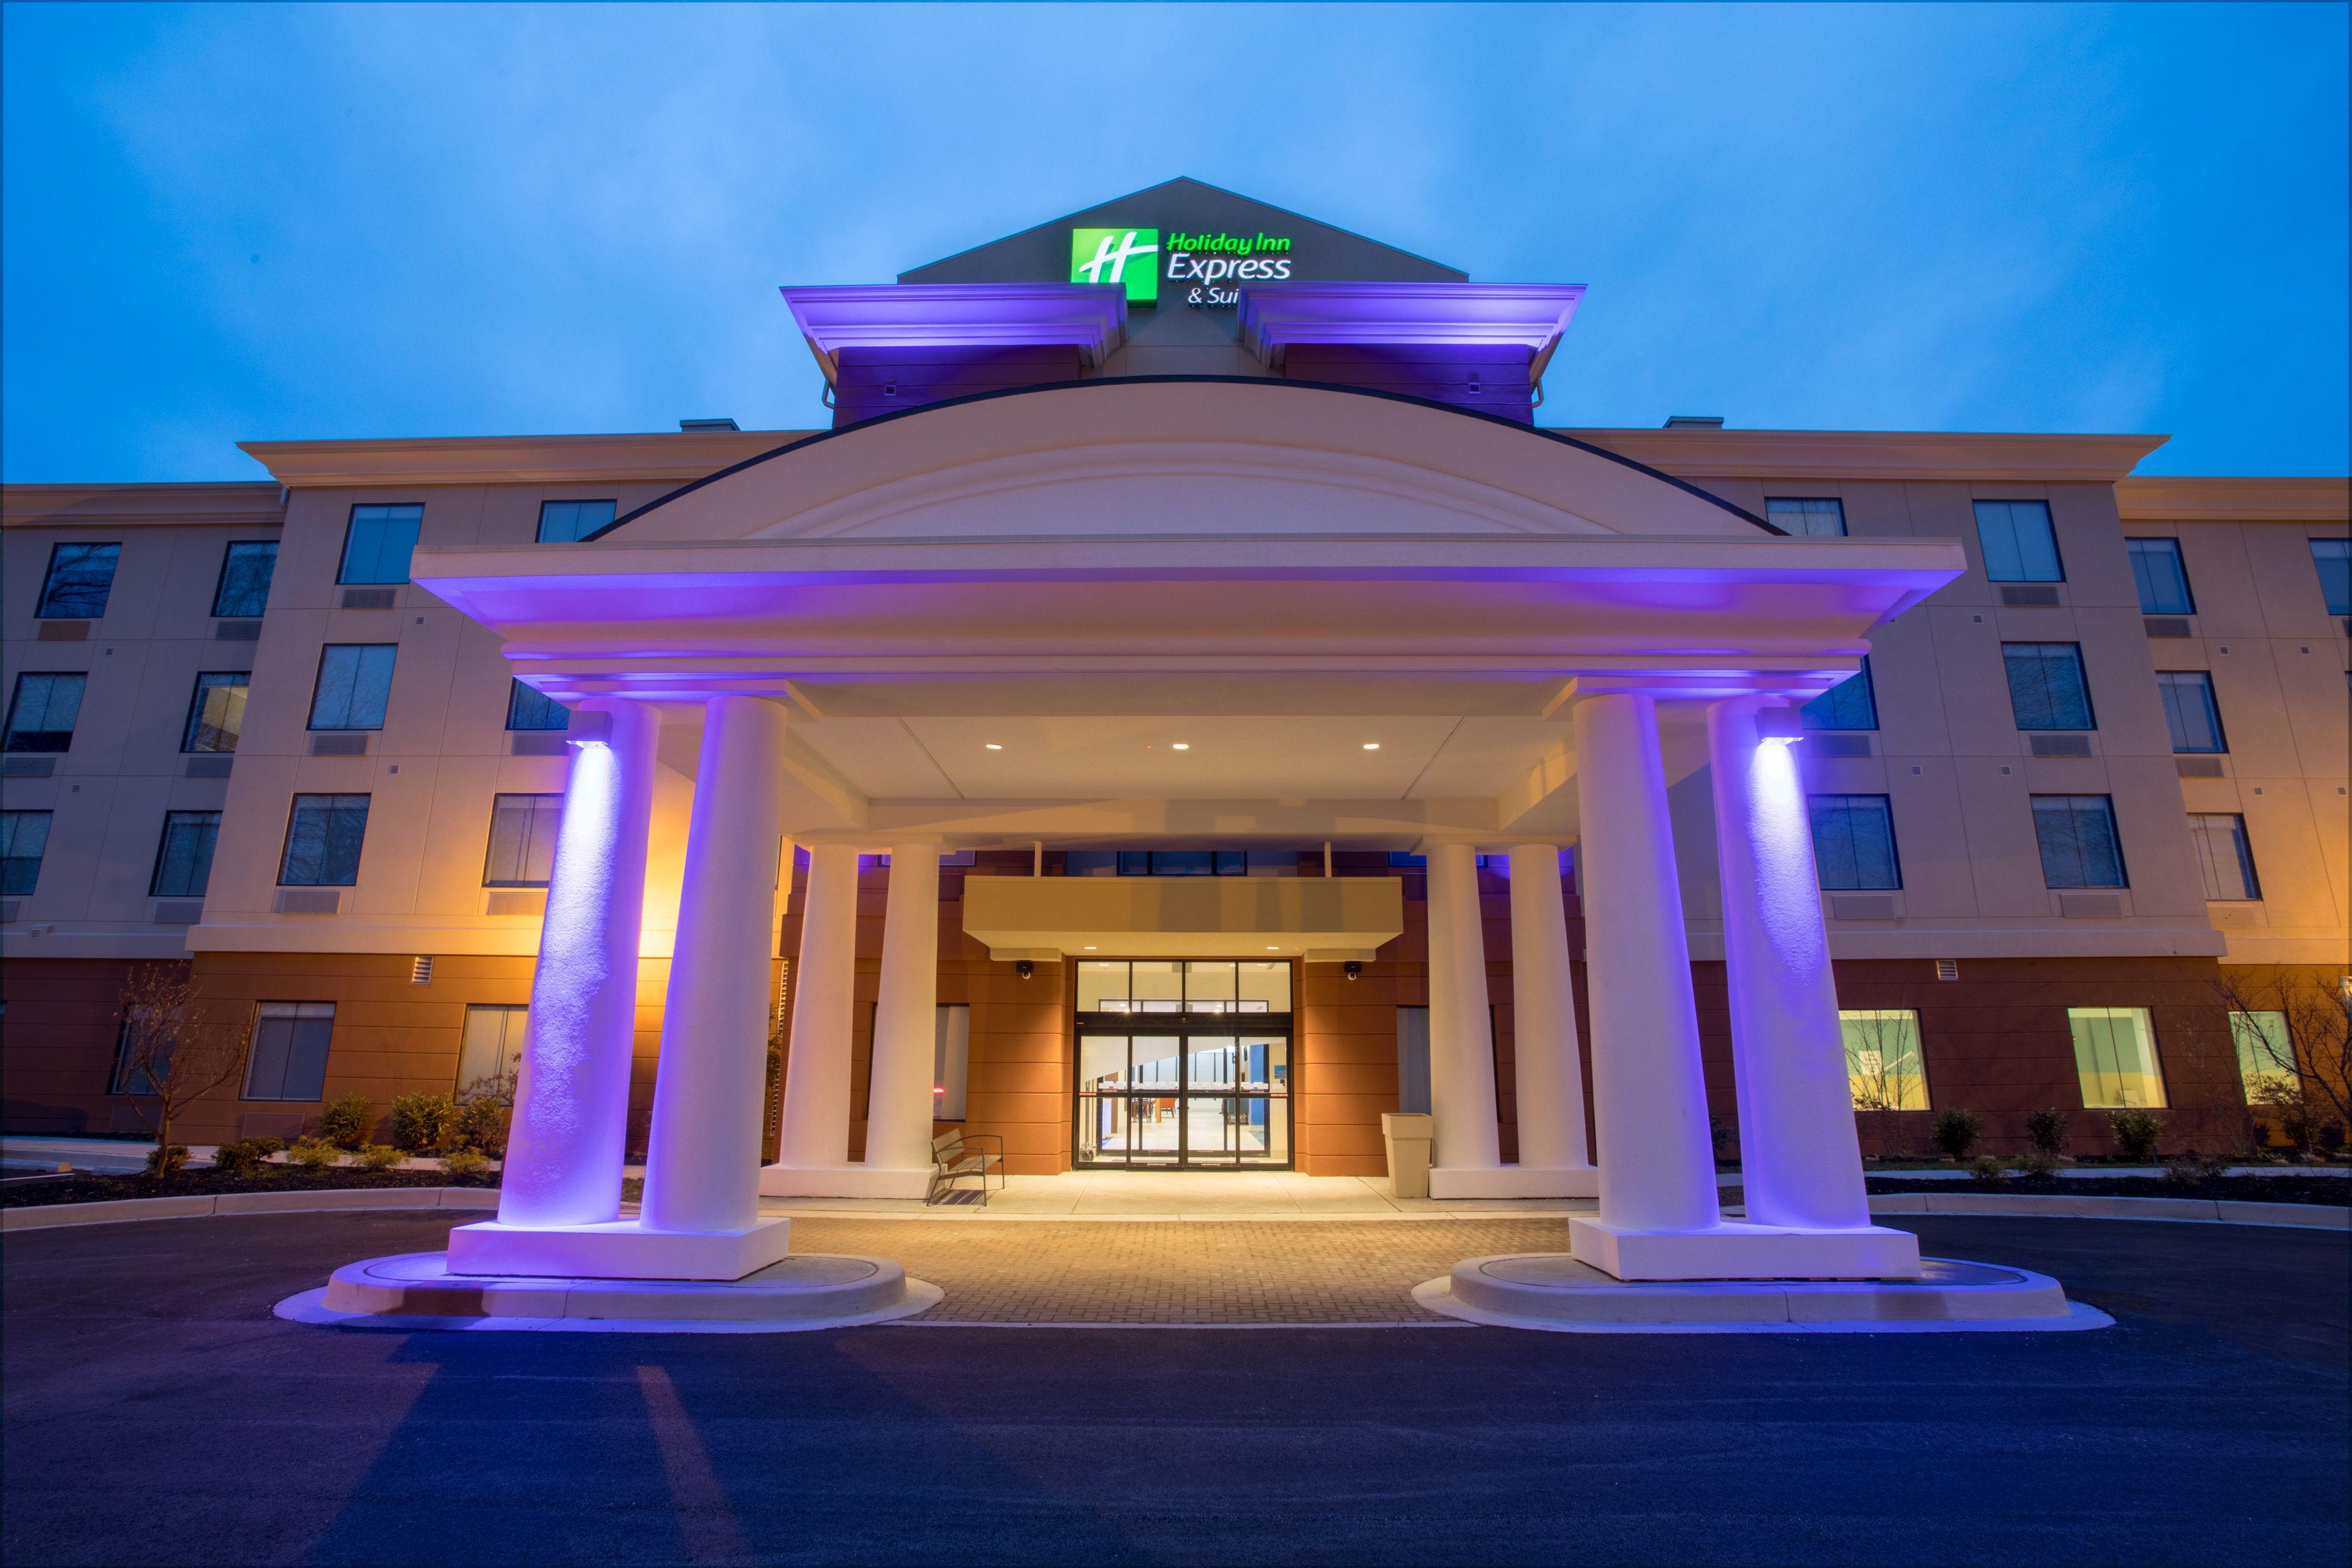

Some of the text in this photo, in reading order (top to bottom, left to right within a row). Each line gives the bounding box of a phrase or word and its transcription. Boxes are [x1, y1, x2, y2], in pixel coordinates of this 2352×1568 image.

[1166, 232, 1291, 255] Holiday Inn
[1167, 254, 1291, 285] Express
[1188, 287, 1239, 304] & Sui
